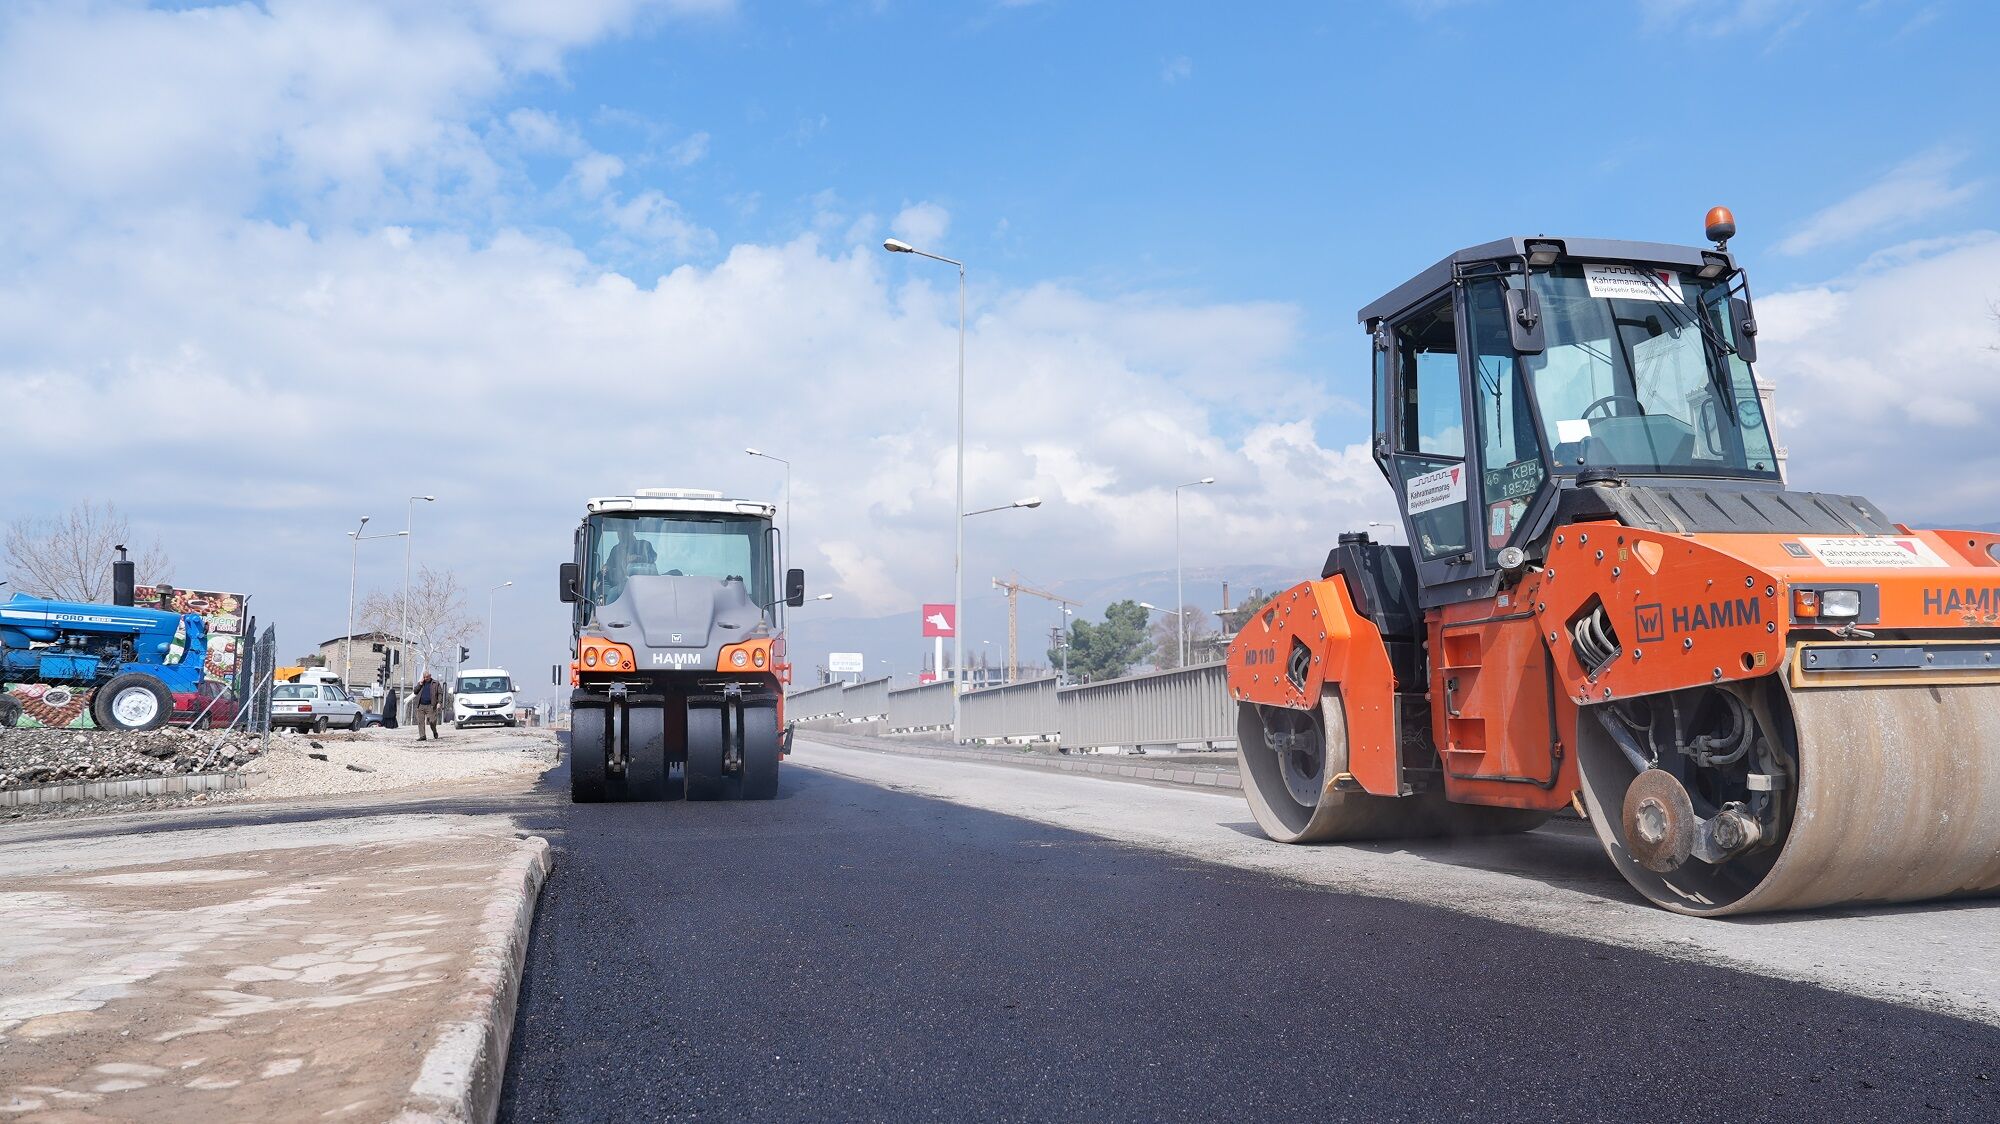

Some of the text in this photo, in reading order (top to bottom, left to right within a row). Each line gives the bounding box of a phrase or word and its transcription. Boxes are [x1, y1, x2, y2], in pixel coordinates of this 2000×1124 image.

[1591, 276, 1658, 290] Kahramanmara
[1512, 463, 1536, 480] KBB
[1503, 478, 1536, 496] 18524
[56, 614, 84, 622] FORD
[1672, 597, 1761, 633] HAMM
[652, 653, 701, 665] HAMM
[1246, 647, 1275, 665] HD 110
